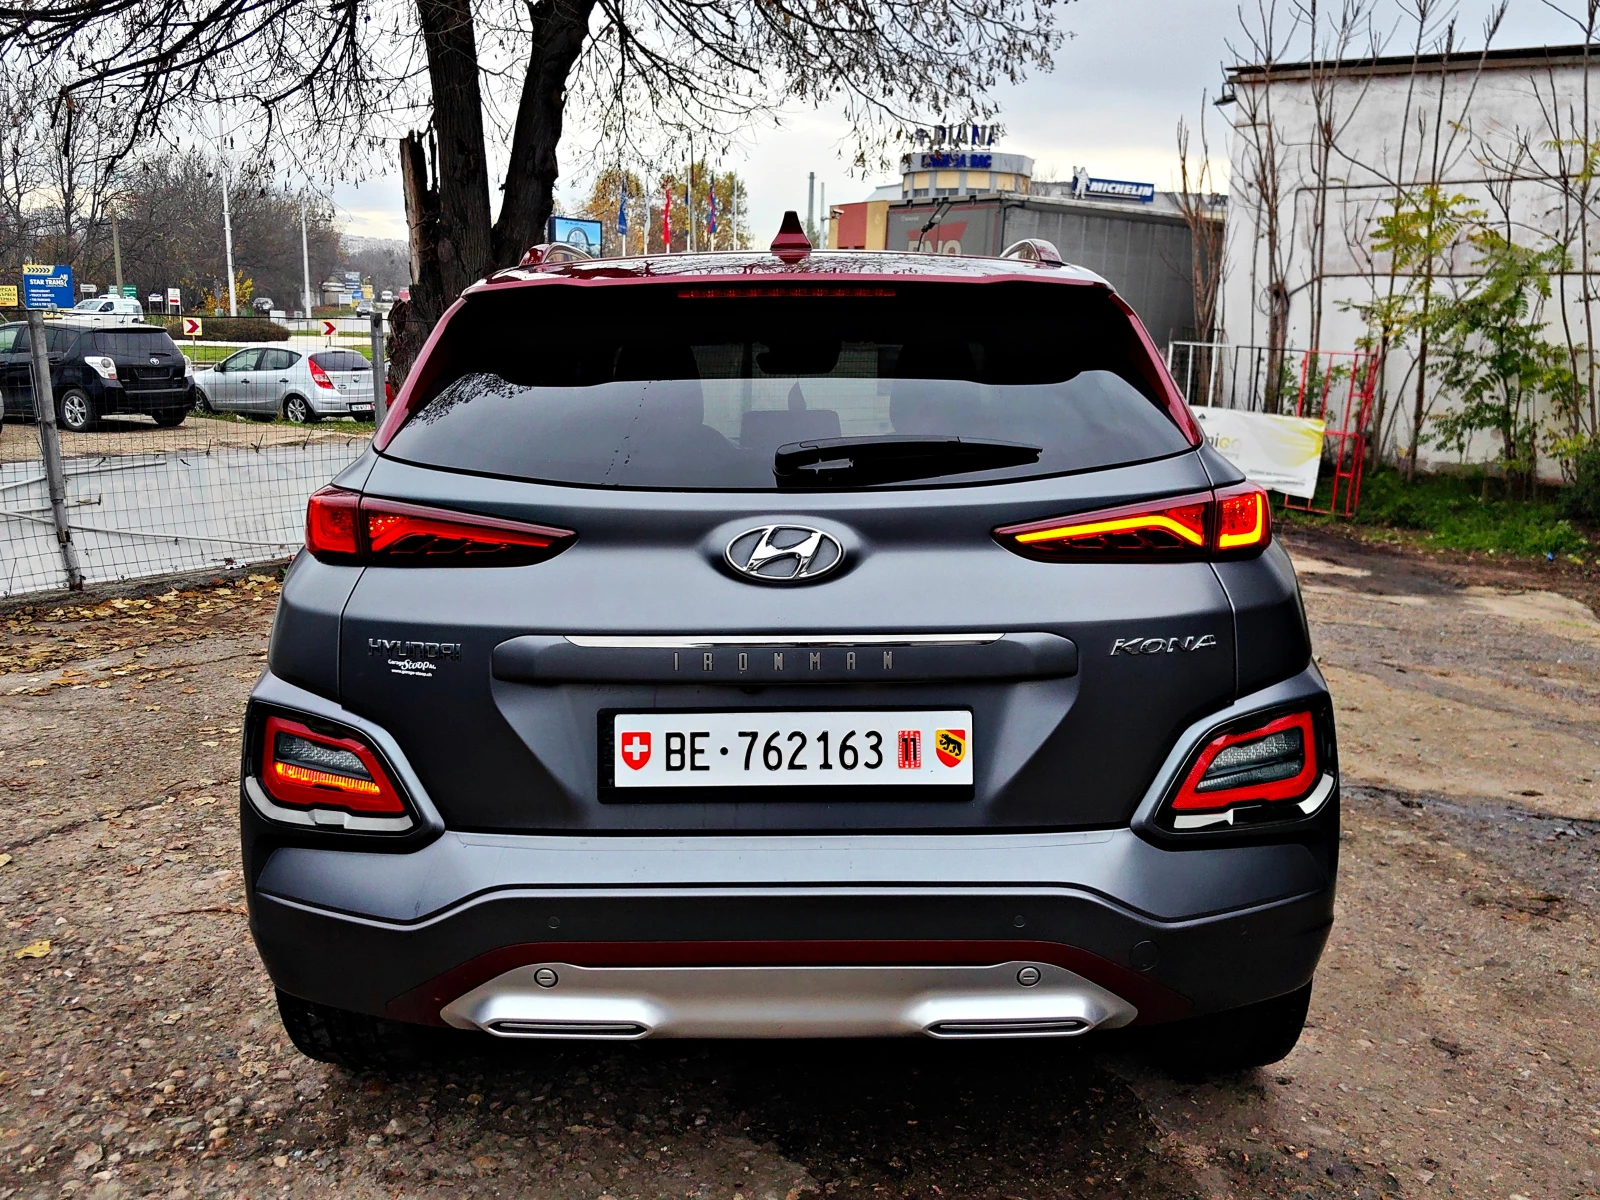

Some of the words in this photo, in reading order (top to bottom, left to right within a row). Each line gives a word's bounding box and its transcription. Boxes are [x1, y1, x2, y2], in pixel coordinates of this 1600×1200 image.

[1089, 181, 1153, 196] MICHELIN
[368, 638, 461, 660] HYUNDAI
[1110, 634, 1217, 656] KONA
[673, 651, 894, 672] IRONMAN
